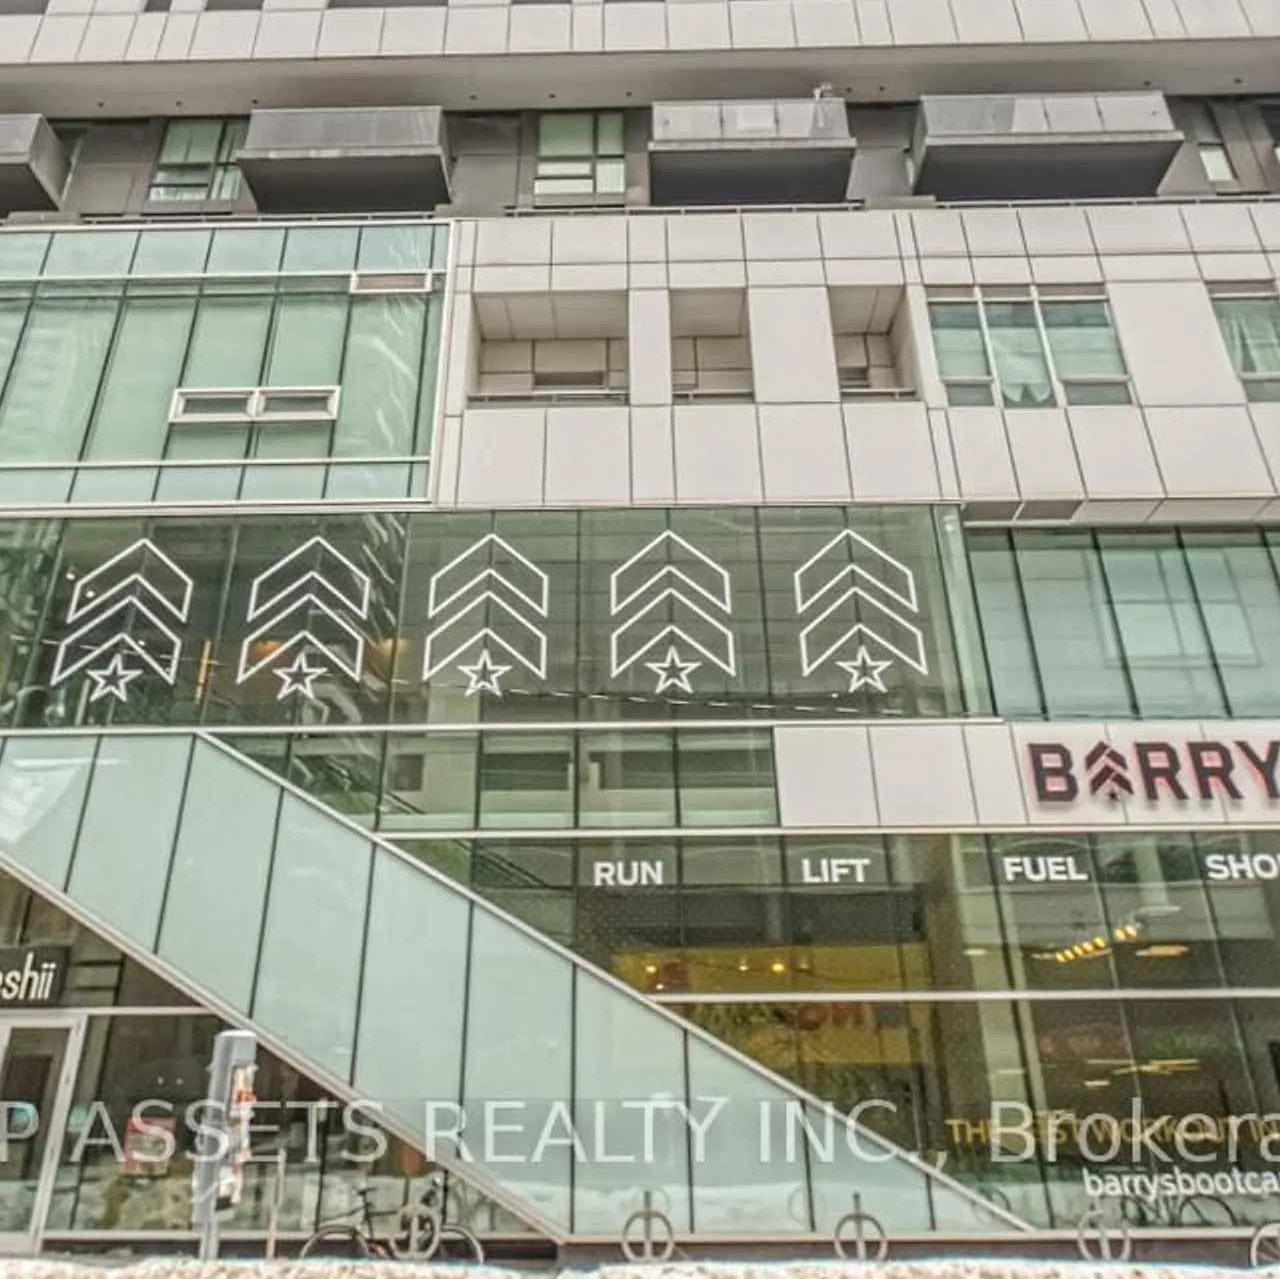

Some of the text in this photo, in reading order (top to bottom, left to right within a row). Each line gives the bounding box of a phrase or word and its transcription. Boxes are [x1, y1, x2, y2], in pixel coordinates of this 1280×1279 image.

[594, 860, 663, 887] RUN
[802, 858, 870, 884] LIFT
[1003, 857, 1088, 883] FUEL
